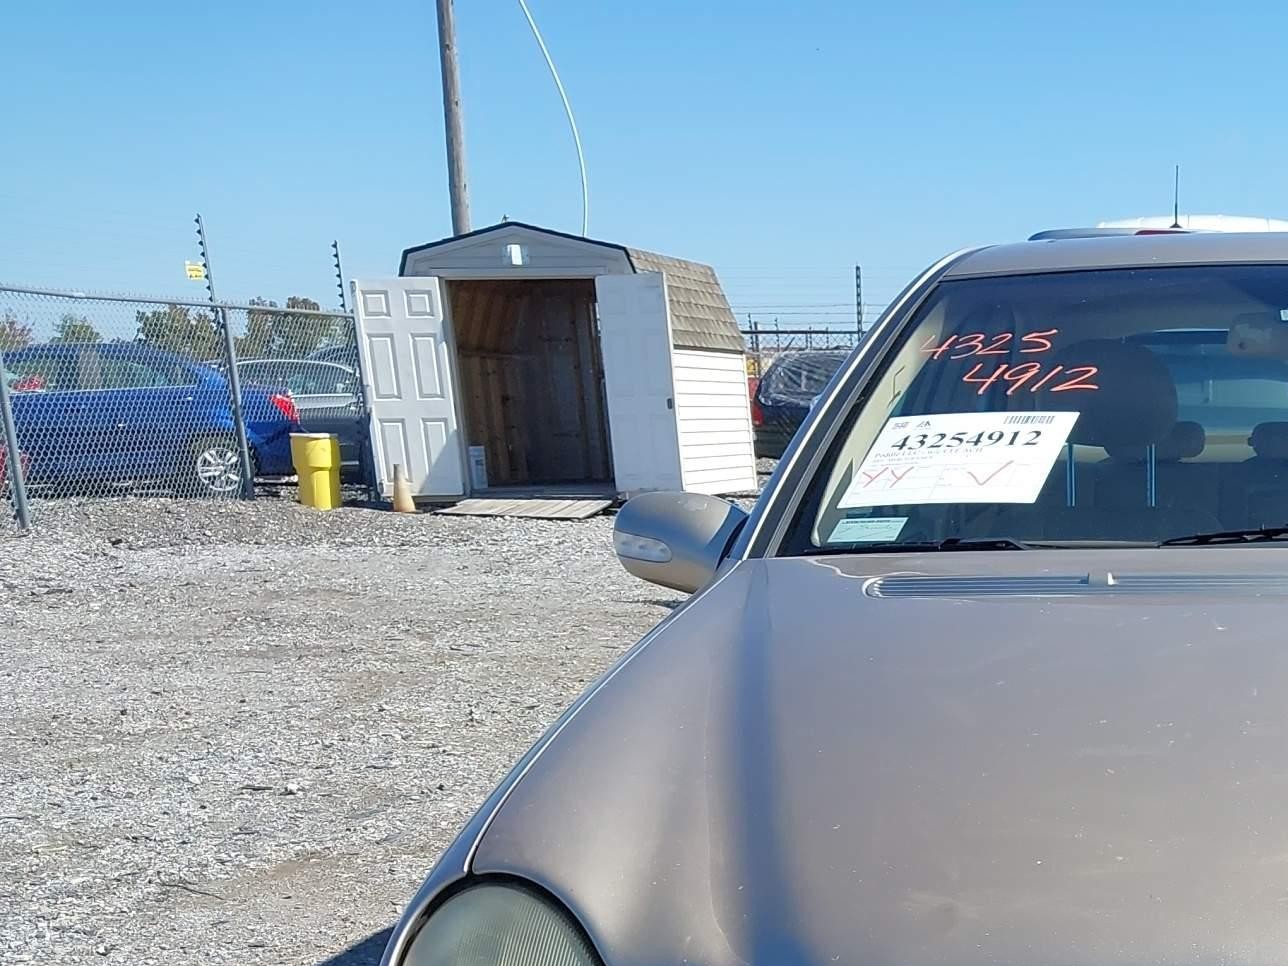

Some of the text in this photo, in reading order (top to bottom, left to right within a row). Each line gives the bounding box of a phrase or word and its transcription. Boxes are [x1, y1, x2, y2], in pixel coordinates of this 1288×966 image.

[920, 329, 1058, 359] 4325
[962, 362, 1100, 396] 4912
[891, 430, 1042, 450] 43254912
